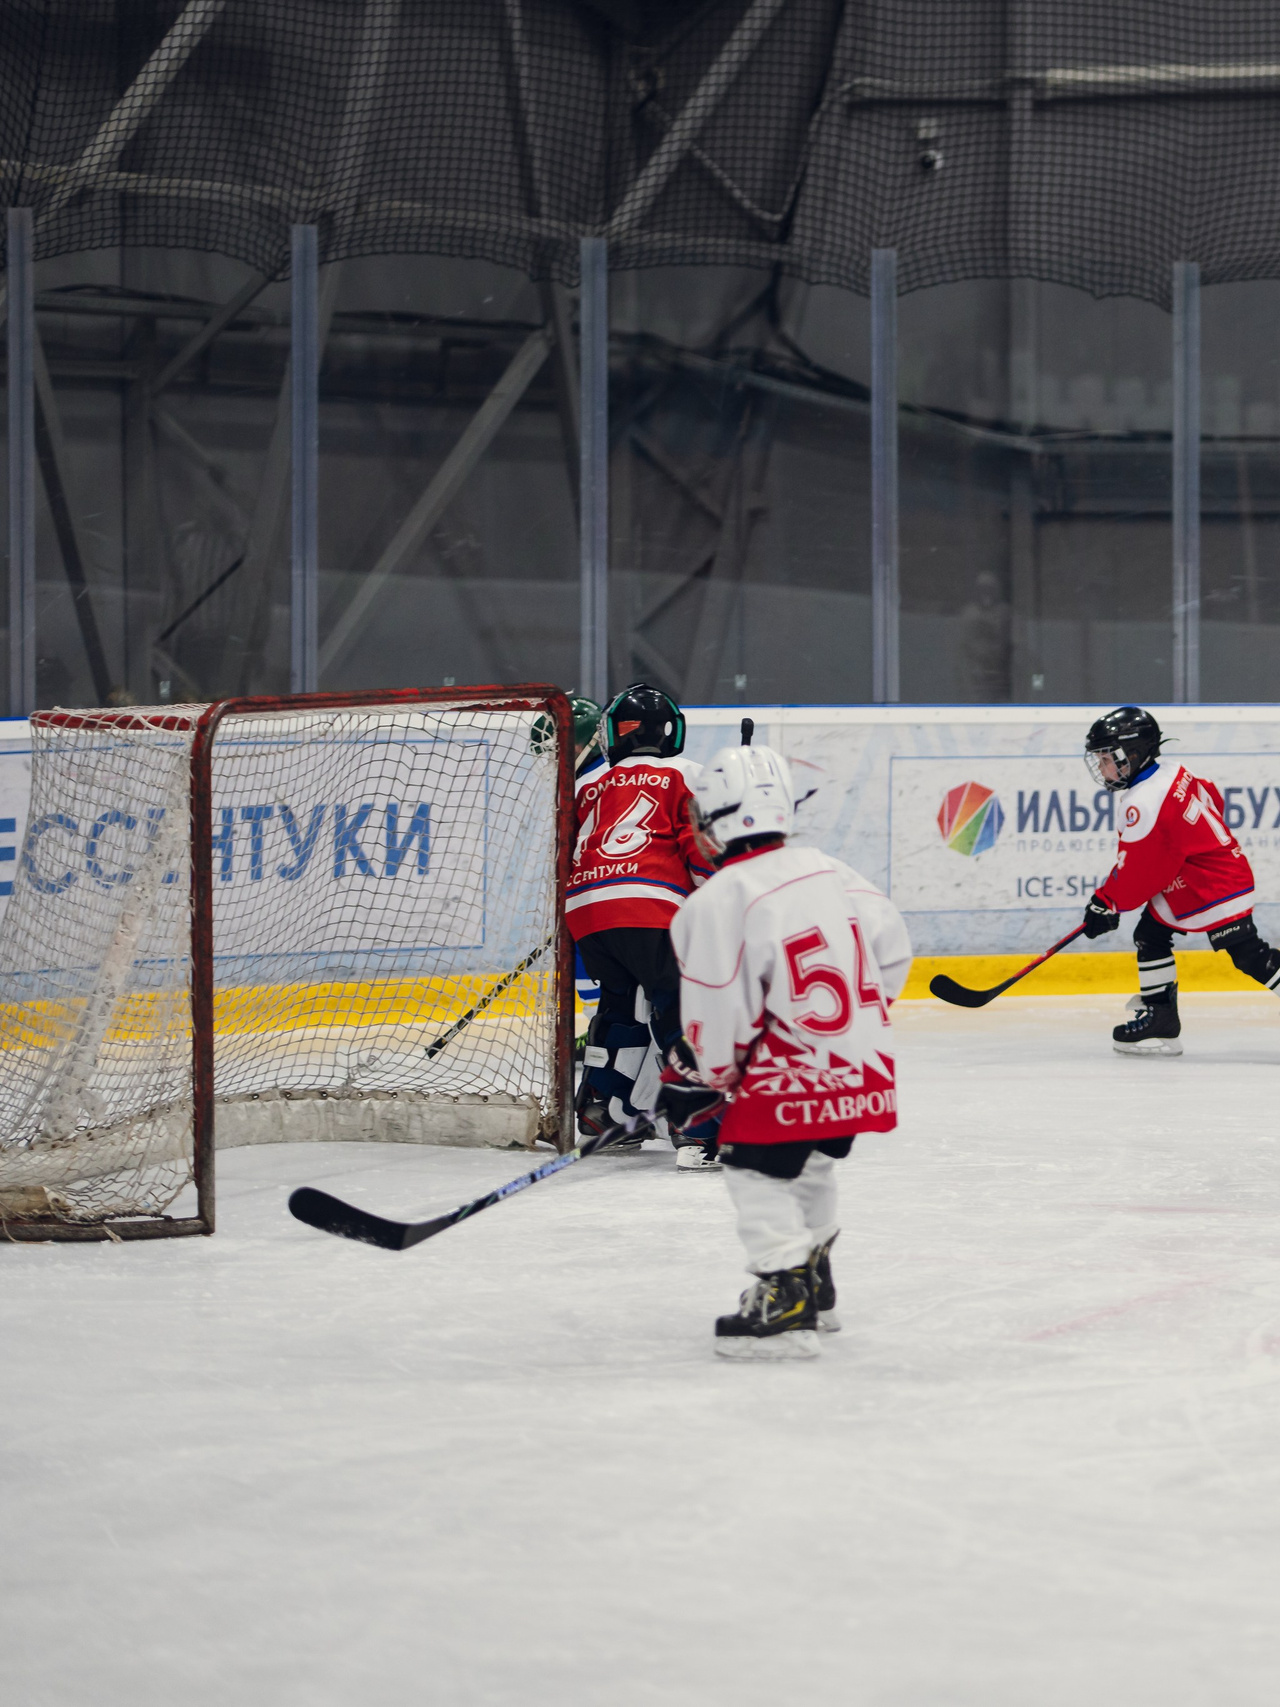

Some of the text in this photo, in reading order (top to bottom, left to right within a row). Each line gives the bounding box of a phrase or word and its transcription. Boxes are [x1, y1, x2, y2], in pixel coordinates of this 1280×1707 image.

[580, 773, 671, 808] ОМАЗАНОВ
[1016, 788, 1115, 833] ИЛЬЯ
[1016, 838, 1119, 852] ПРОДЮСЕР
[1016, 875, 1107, 898] ICE-SH
[781, 917, 892, 1037] 54
